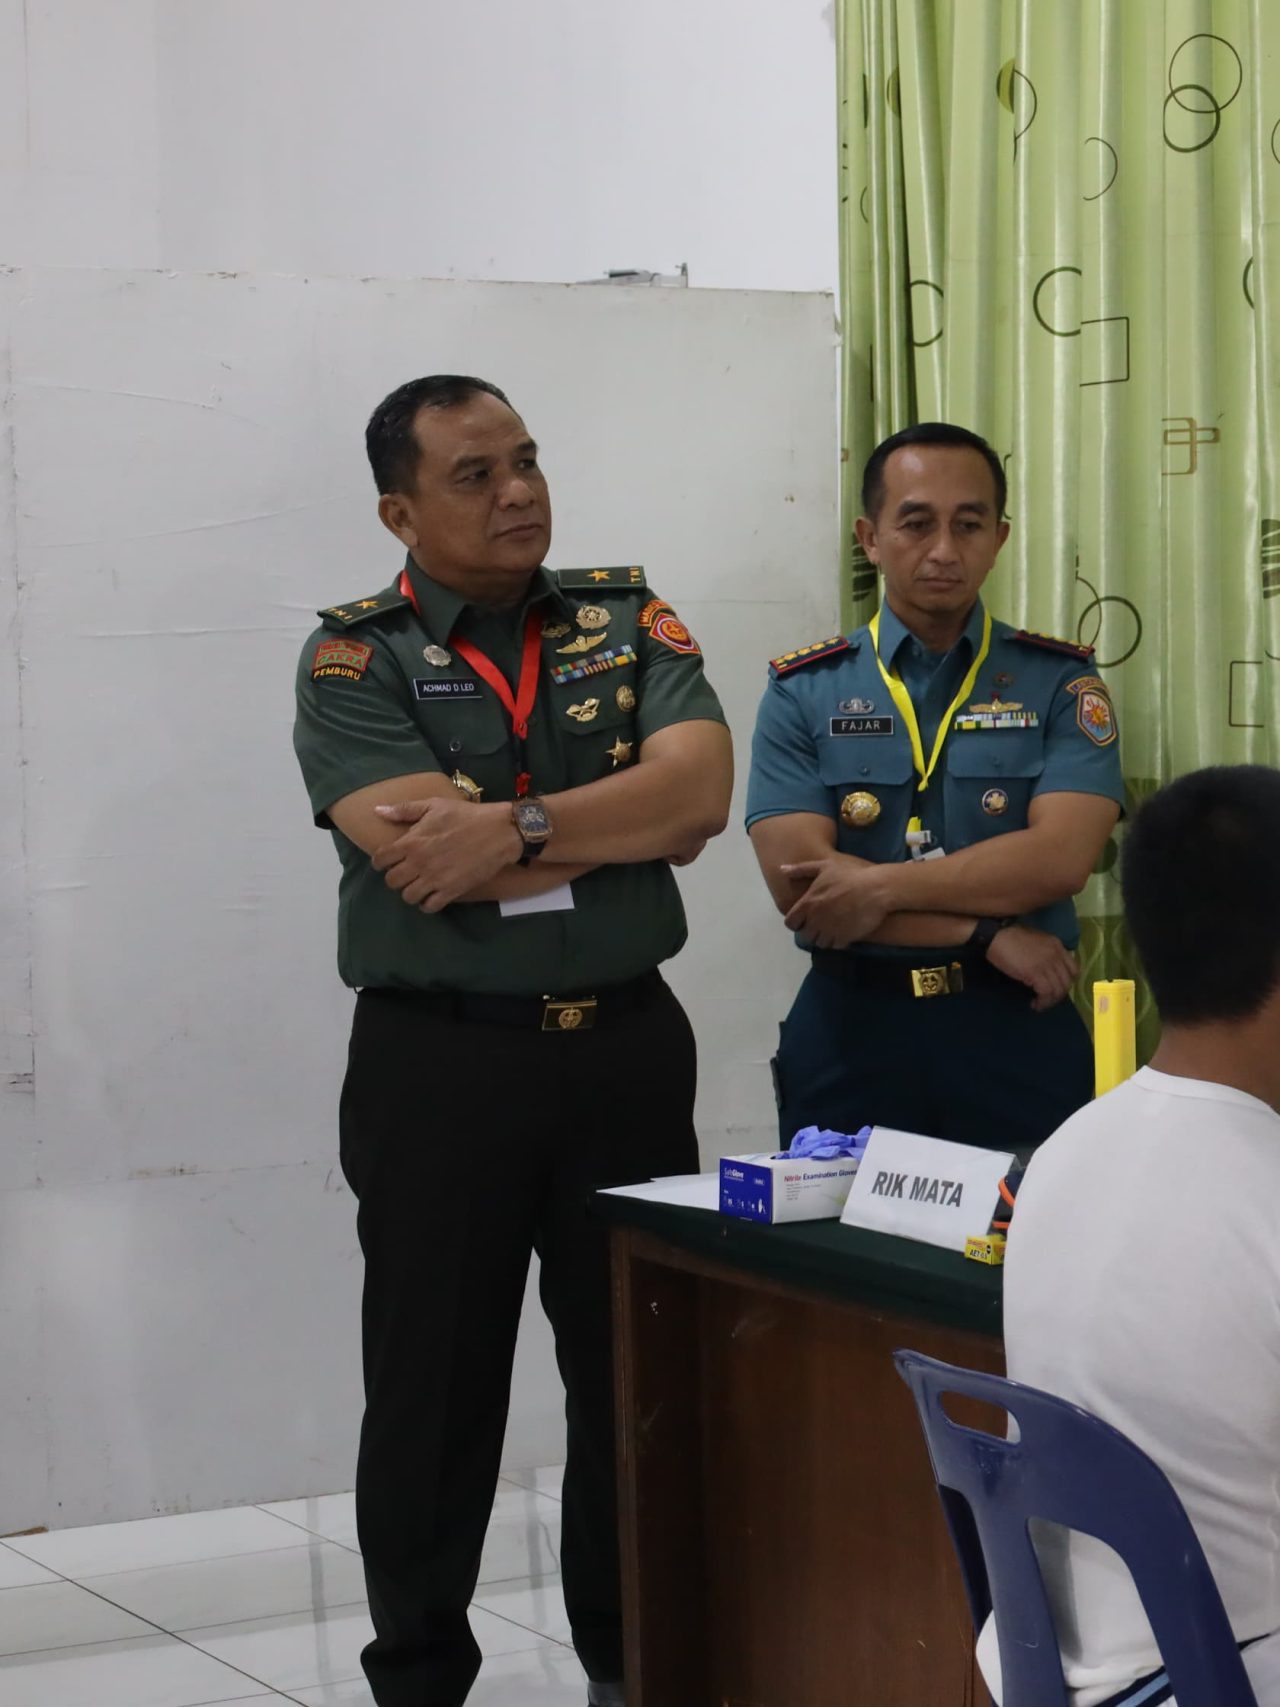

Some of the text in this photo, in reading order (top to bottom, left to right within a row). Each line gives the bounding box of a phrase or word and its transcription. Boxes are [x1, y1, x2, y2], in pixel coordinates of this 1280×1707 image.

[313, 666, 361, 680] PEMBURU
[423, 684, 452, 692] ACHMAD
[460, 683, 475, 691] LEO
[841, 720, 881, 731] FAJAR
[784, 1174, 801, 1182] Nitrile
[803, 1171, 837, 1180] Examination
[871, 1171, 964, 1208] RIK MATA
